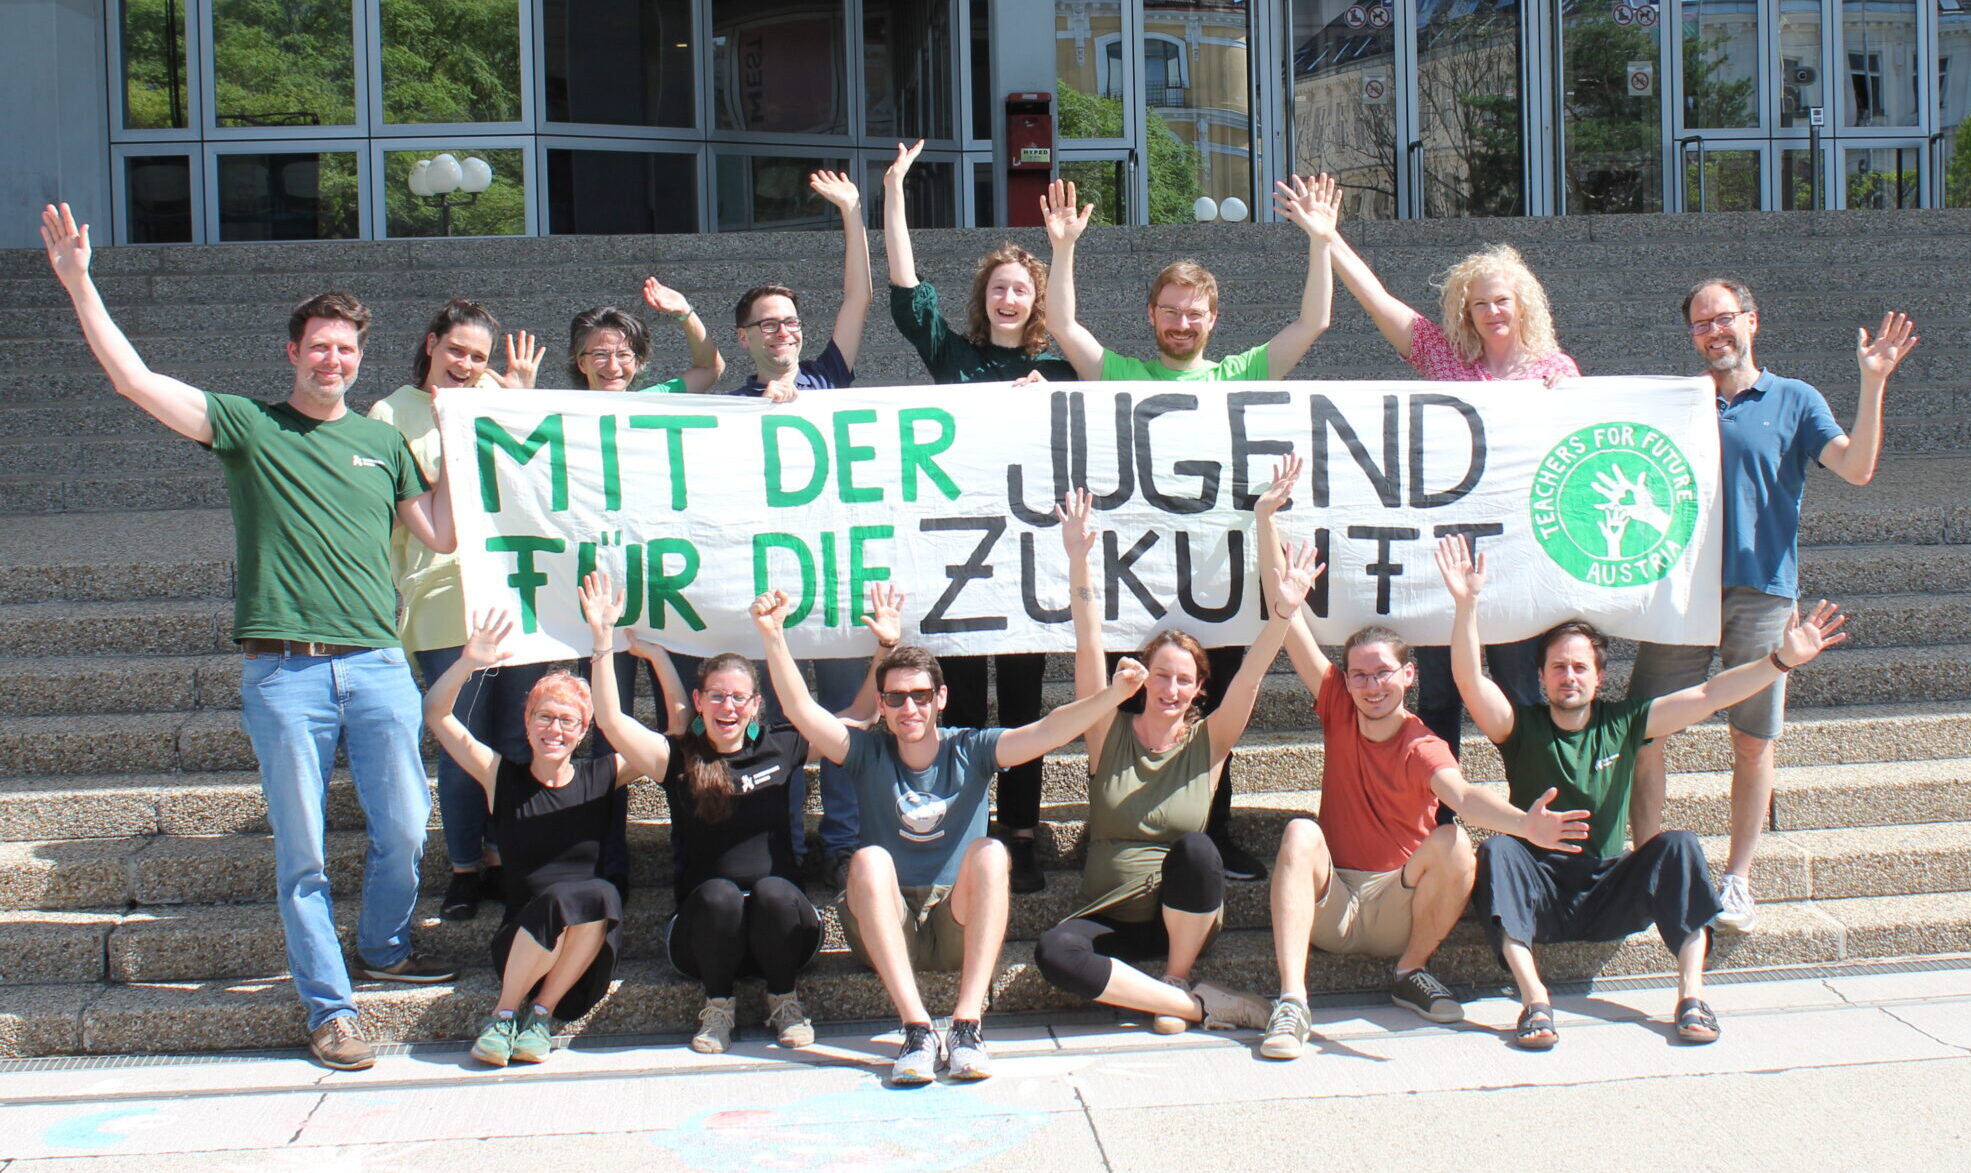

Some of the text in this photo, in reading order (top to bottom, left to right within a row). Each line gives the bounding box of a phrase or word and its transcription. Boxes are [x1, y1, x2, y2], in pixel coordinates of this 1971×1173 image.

[475, 391, 1486, 527] MIT DER JUGEND
[1533, 426, 1694, 540] TEACHERS FOR FUTURE
[486, 531, 707, 634] FÜR
[753, 525, 894, 629] DIE
[1586, 539, 1682, 585] AUSTRIA
